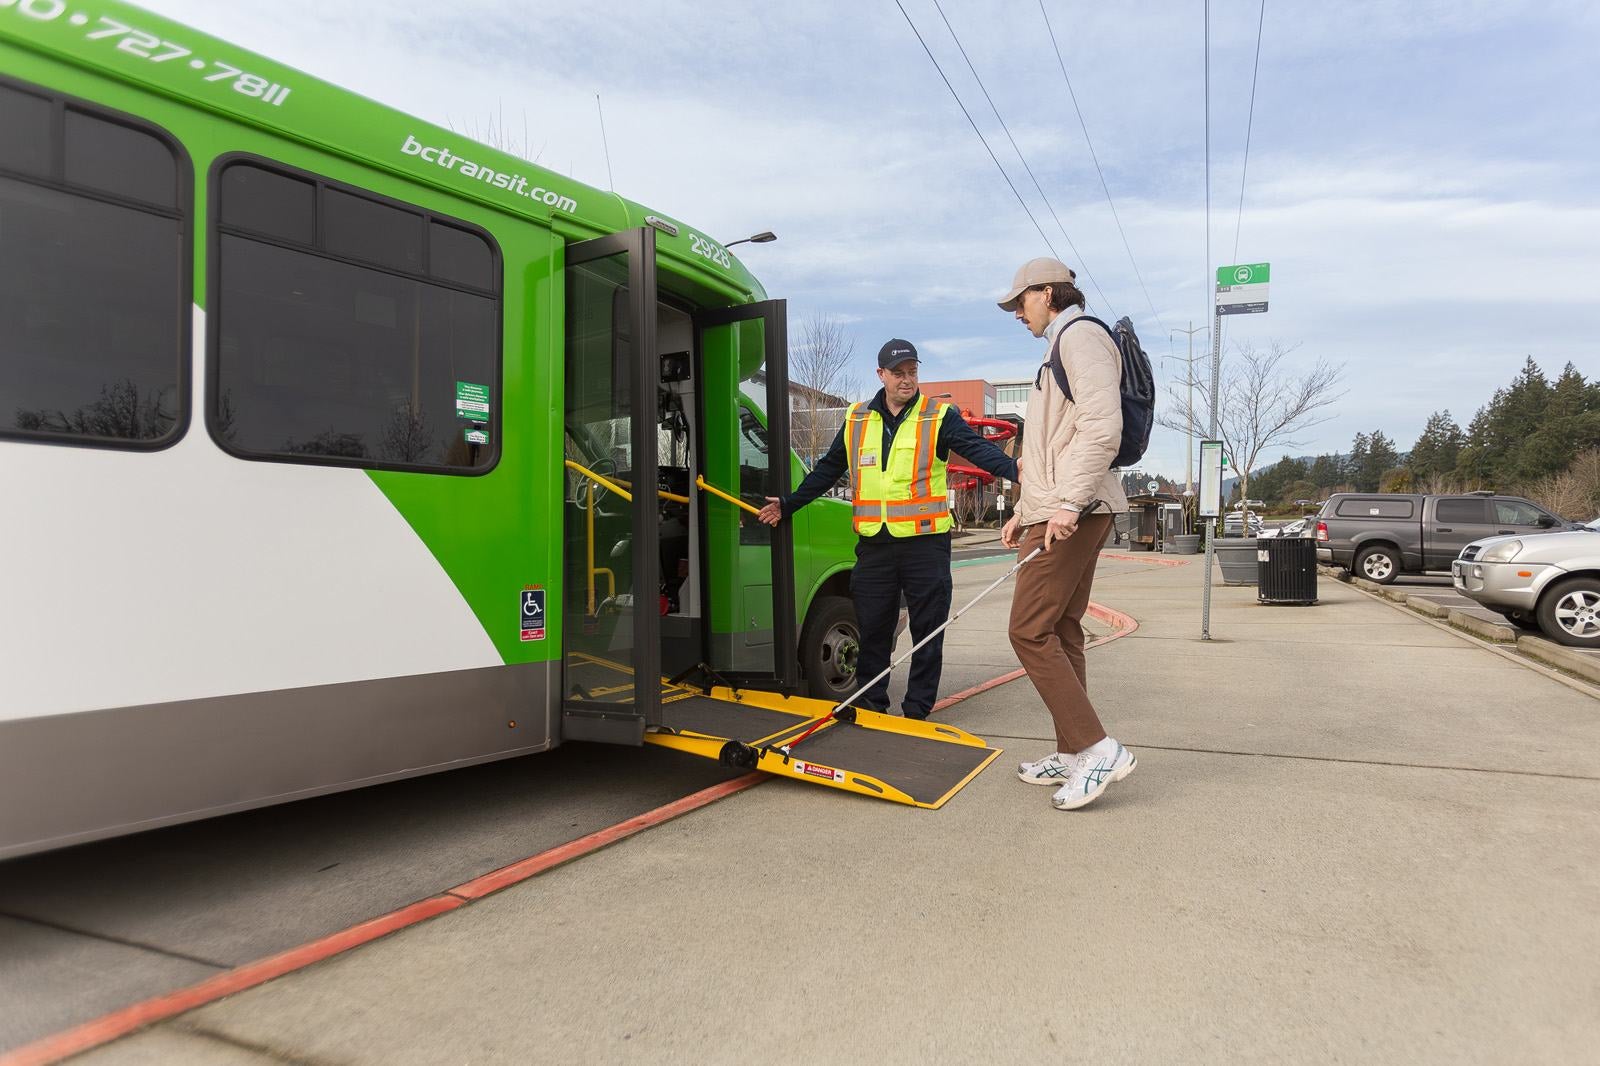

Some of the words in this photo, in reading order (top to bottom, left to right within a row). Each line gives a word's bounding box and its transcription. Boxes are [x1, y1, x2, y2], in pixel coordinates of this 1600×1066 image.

[400, 135, 578, 214] bctransit.com
[688, 233, 732, 270] 2928
[812, 766, 832, 776] DANGER
